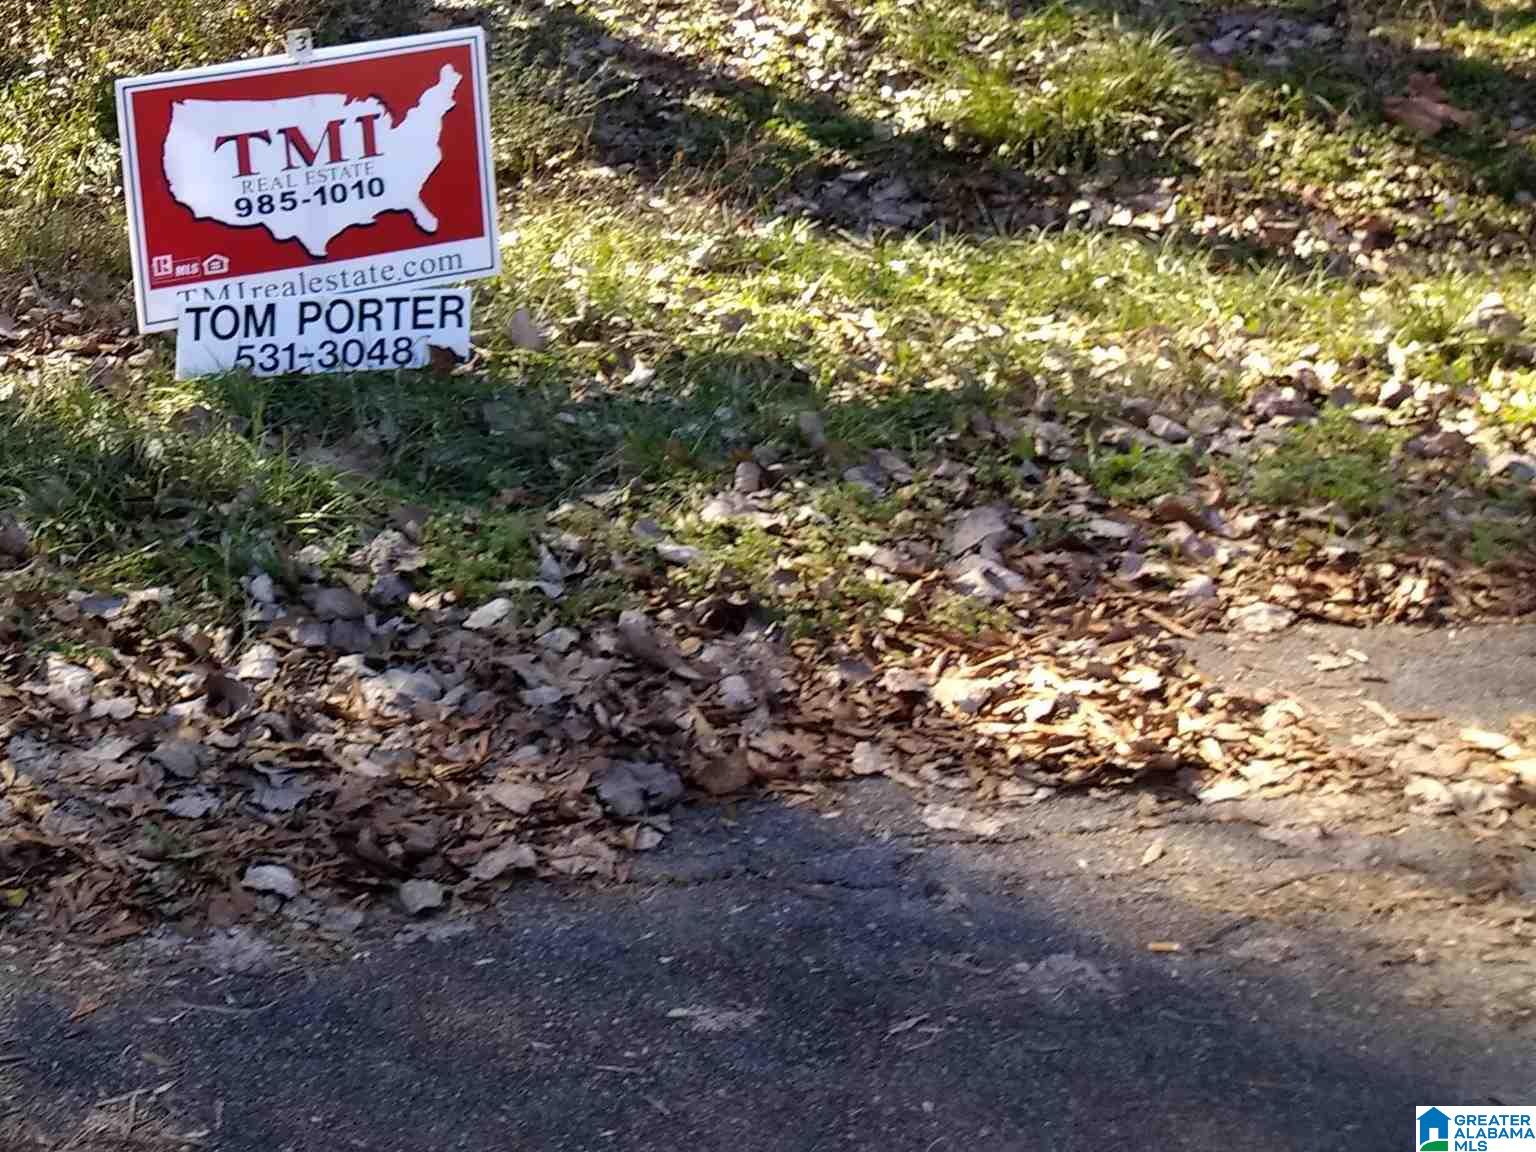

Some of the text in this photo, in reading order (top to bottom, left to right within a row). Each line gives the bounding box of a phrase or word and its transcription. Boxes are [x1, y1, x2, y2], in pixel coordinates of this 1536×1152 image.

[214, 113, 384, 178] TMI
[234, 177, 385, 218] 985-1010
[242, 160, 375, 194] REAL ESTATE
[185, 294, 464, 341] TOM PORTER
[235, 336, 413, 372] 531-3048
